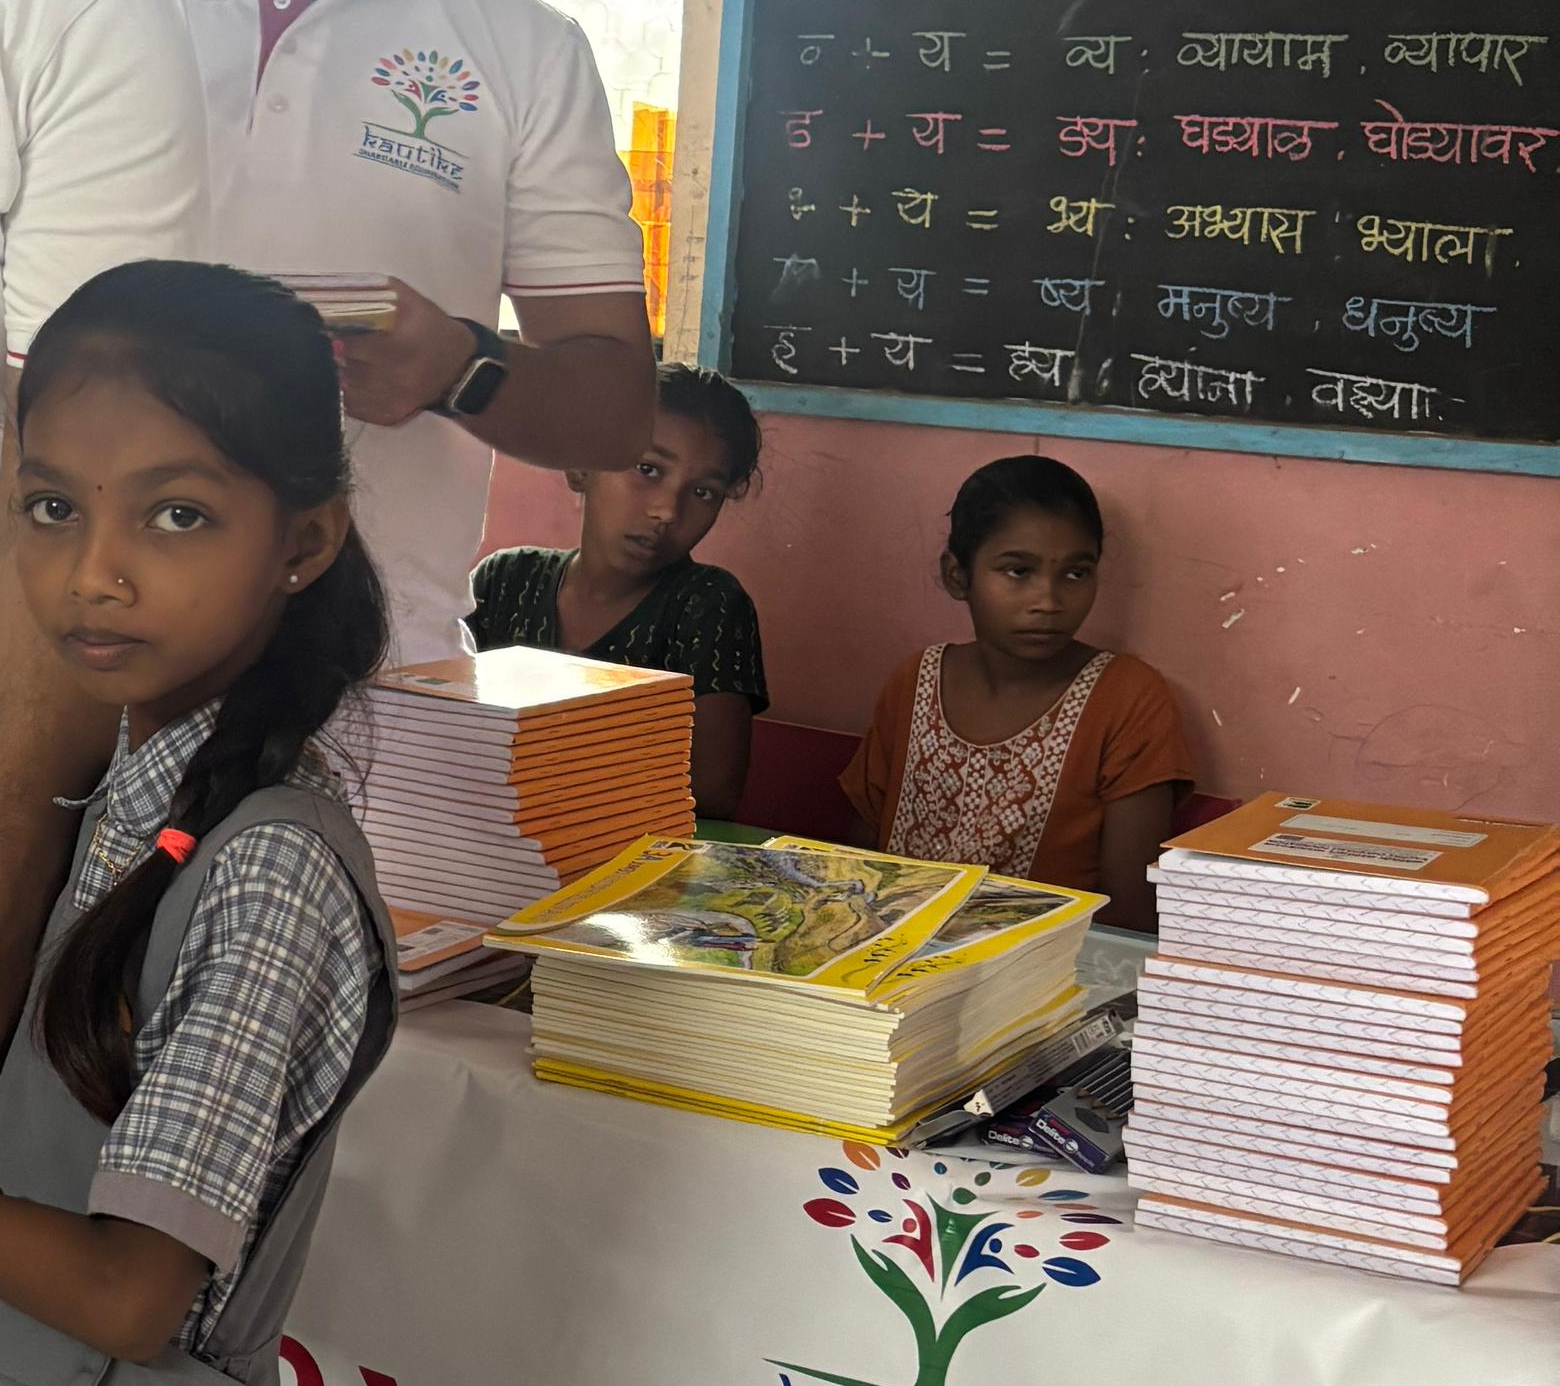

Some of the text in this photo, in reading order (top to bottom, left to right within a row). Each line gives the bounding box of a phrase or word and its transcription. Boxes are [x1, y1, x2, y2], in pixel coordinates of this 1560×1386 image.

[912, 31, 967, 72] य
[1384, 32, 1549, 87] व्यापार
[362, 125, 464, 181] kautike
[905, 111, 963, 155] य
[870, 331, 934, 371] य
[1035, 1118, 1065, 1145] Delite
